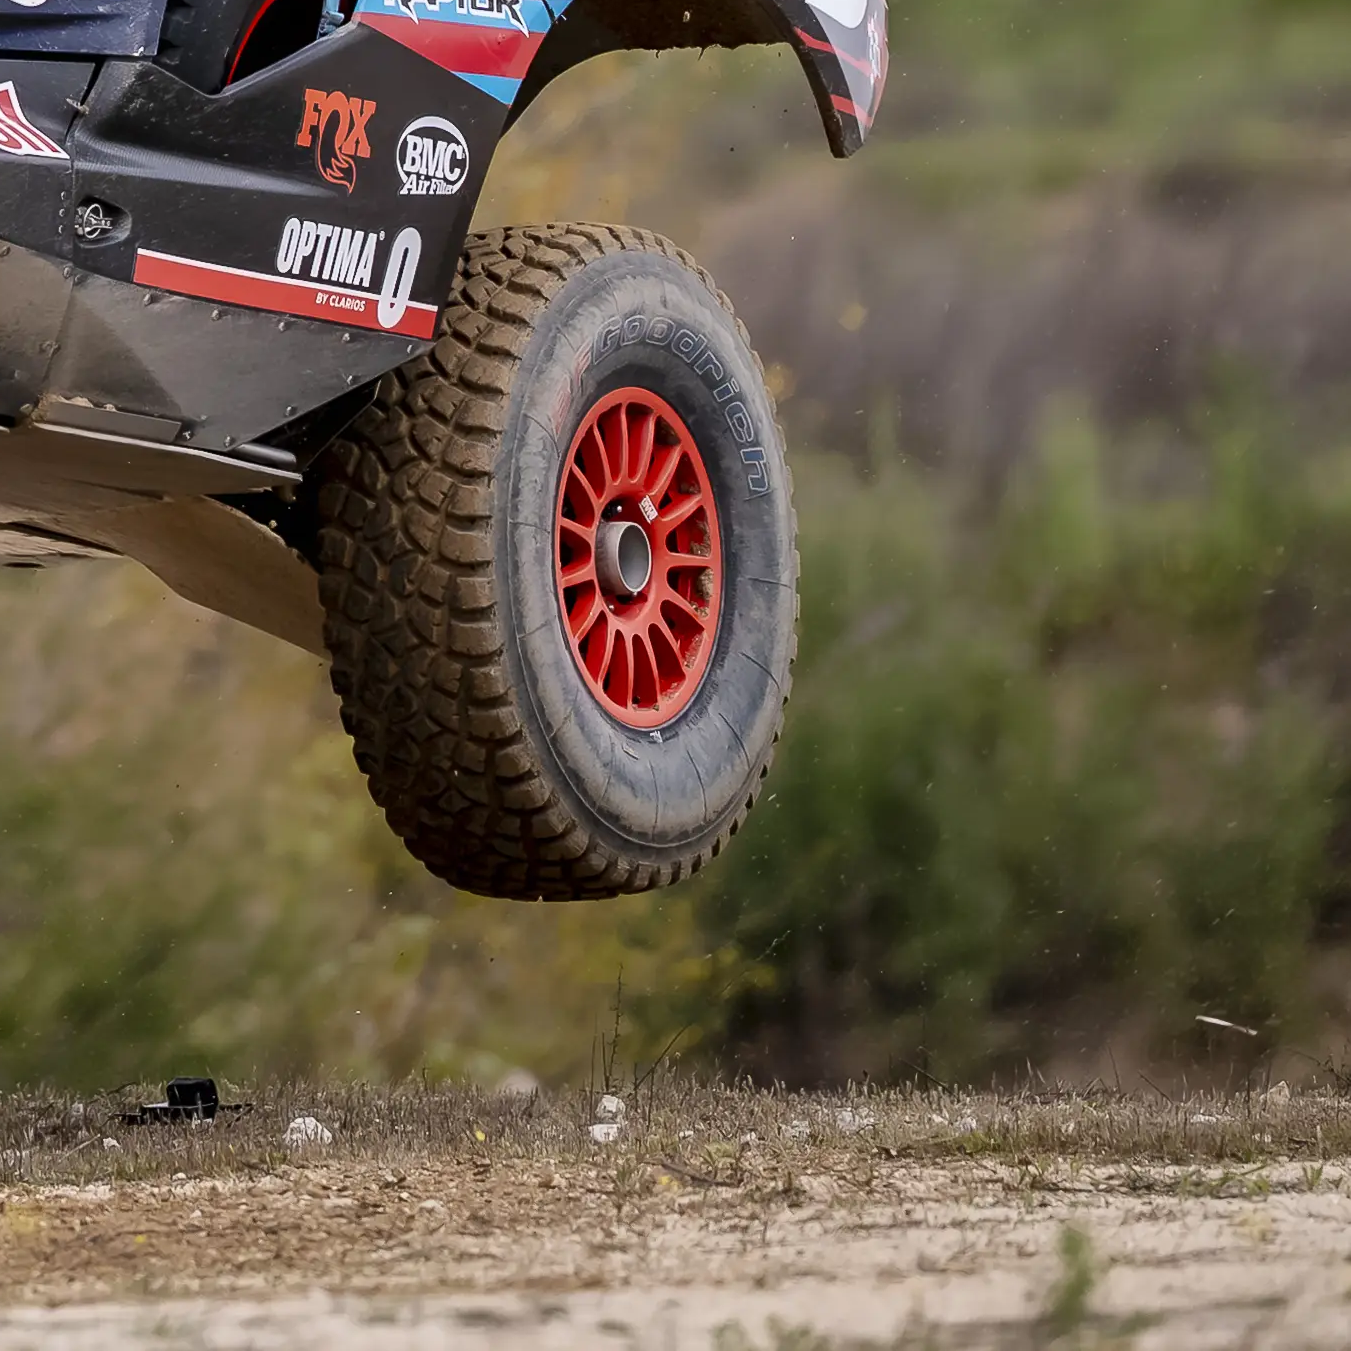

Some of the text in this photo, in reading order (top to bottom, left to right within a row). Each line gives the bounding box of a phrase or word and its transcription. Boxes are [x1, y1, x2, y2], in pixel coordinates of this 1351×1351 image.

[297, 88, 377, 181] FOX
[403, 134, 465, 182] BMC
[400, 173, 431, 195] Air
[315, 292, 366, 312] BY CLARIOS
